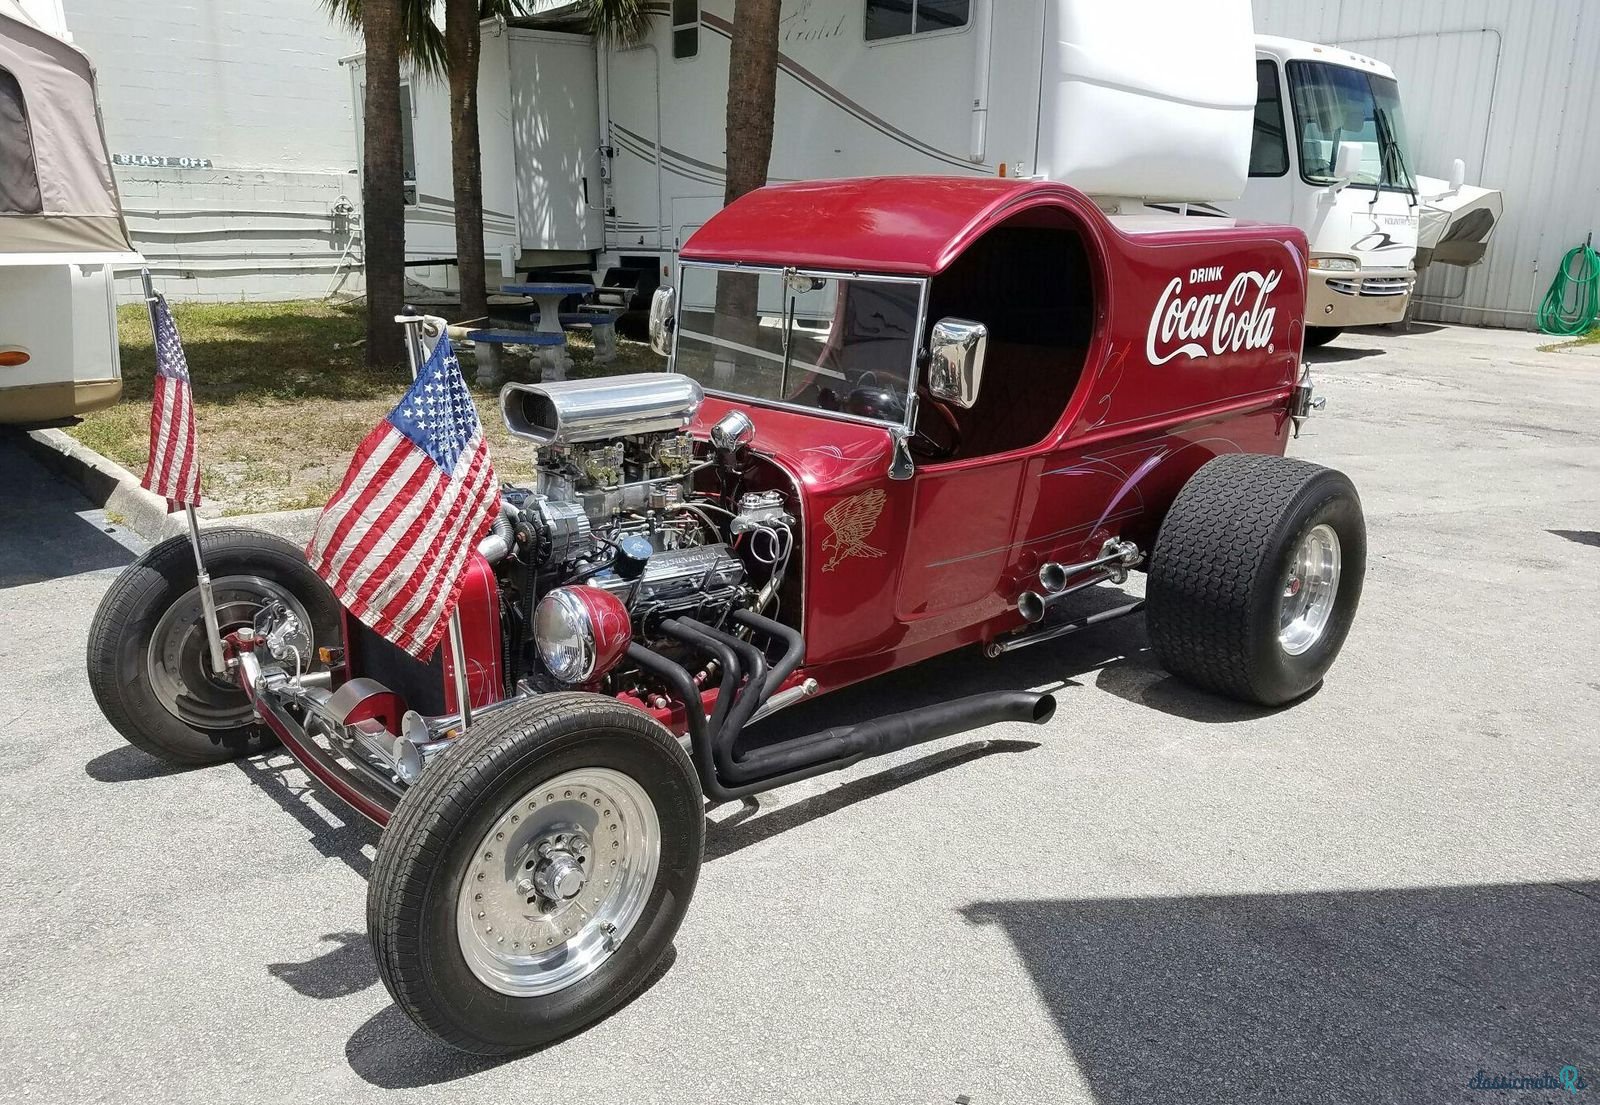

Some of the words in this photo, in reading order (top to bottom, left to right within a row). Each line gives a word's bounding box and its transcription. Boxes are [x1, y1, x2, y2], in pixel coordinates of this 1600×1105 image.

[119, 154, 169, 167] BLAST
[179, 157, 208, 168] OFF
[1189, 265, 1224, 284] DRINK
[1146, 269, 1283, 366] Coca-Cola
